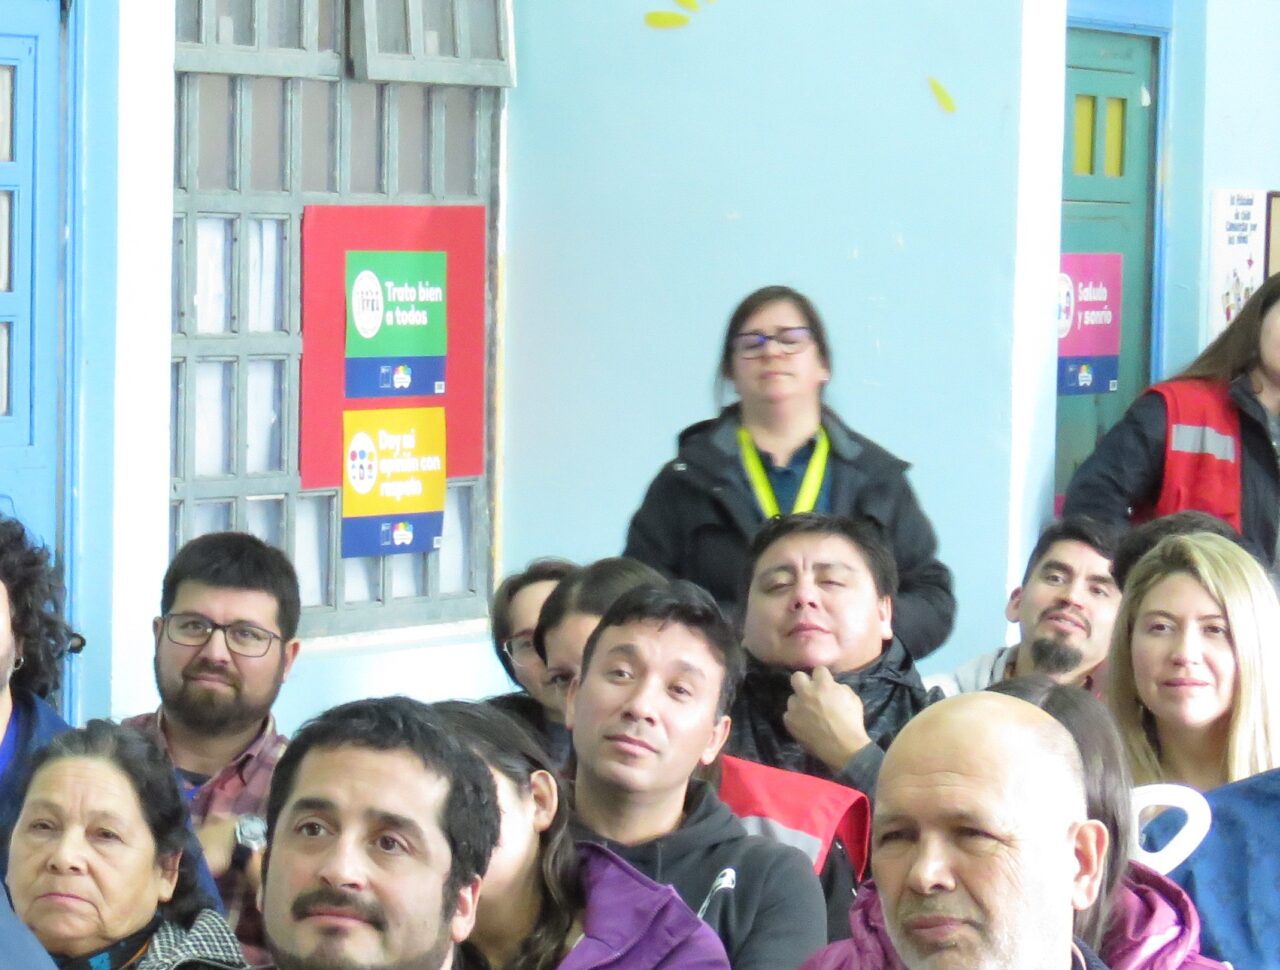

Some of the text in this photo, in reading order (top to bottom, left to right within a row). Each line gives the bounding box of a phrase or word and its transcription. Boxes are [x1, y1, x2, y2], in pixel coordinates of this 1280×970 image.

[384, 280, 442, 302] Trato bien
[386, 305, 428, 326] a todos
[420, 455, 441, 472] con
